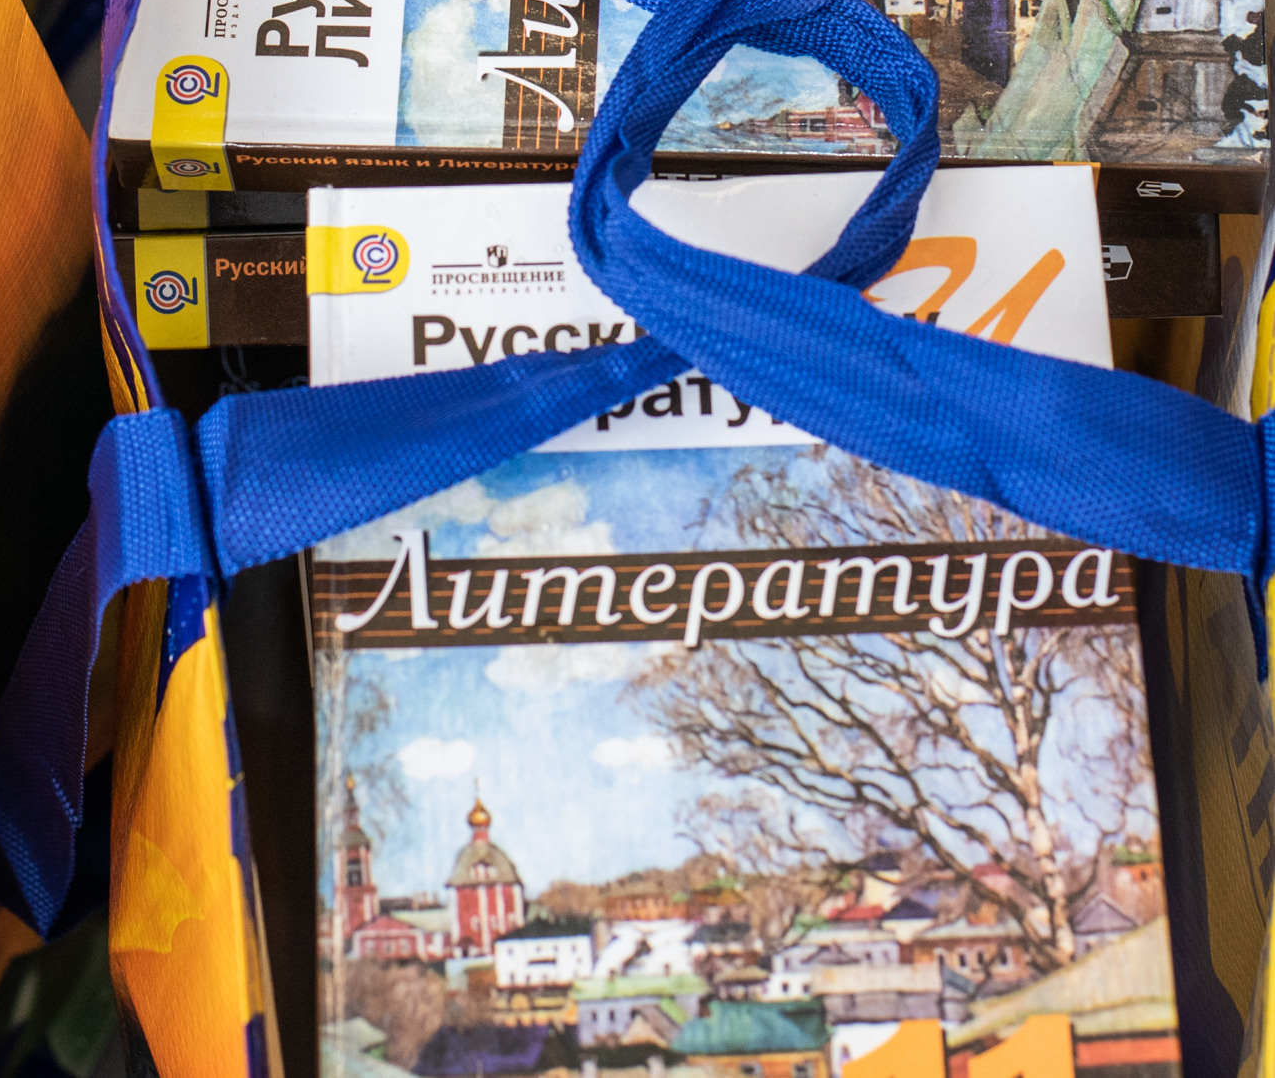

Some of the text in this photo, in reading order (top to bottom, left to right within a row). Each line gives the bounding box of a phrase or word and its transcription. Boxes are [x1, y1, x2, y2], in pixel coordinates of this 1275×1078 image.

[236, 153, 338, 171] Русский
[345, 157, 409, 168] язык
[416, 158, 431, 168] и
[432, 271, 566, 286] ПРОСВЕЩЕНИЕ
[412, 313, 646, 368] Русск
[336, 529, 1120, 650] Литература
